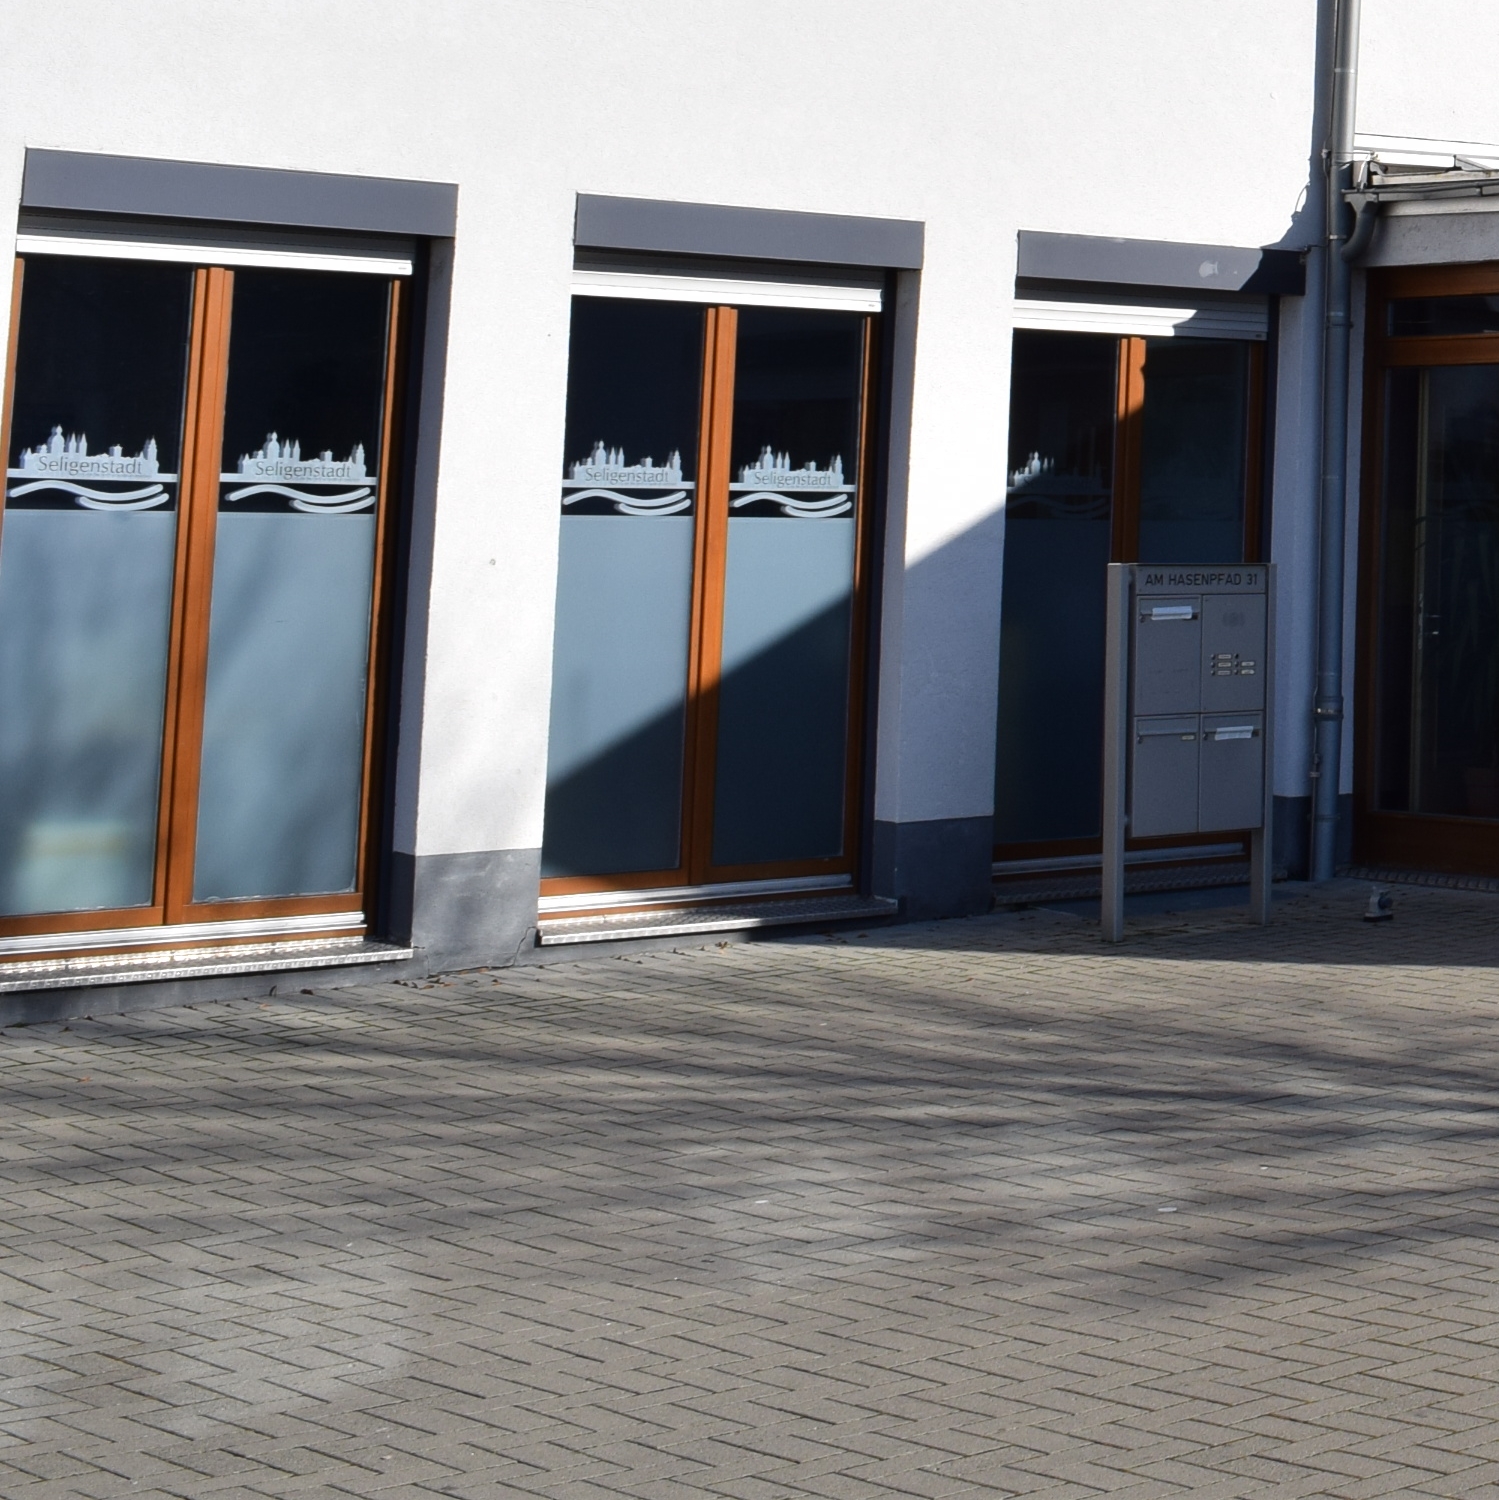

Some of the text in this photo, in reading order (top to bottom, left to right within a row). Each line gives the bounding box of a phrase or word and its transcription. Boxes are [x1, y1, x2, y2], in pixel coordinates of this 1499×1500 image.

[38, 455, 143, 476] Seligenstadt
[255, 461, 352, 481] Seligenstadt
[585, 467, 669, 485] Seligenstadt
[754, 471, 832, 488] Seligenstadt
[1145, 573, 1258, 586] AM HASENPFAD 31
